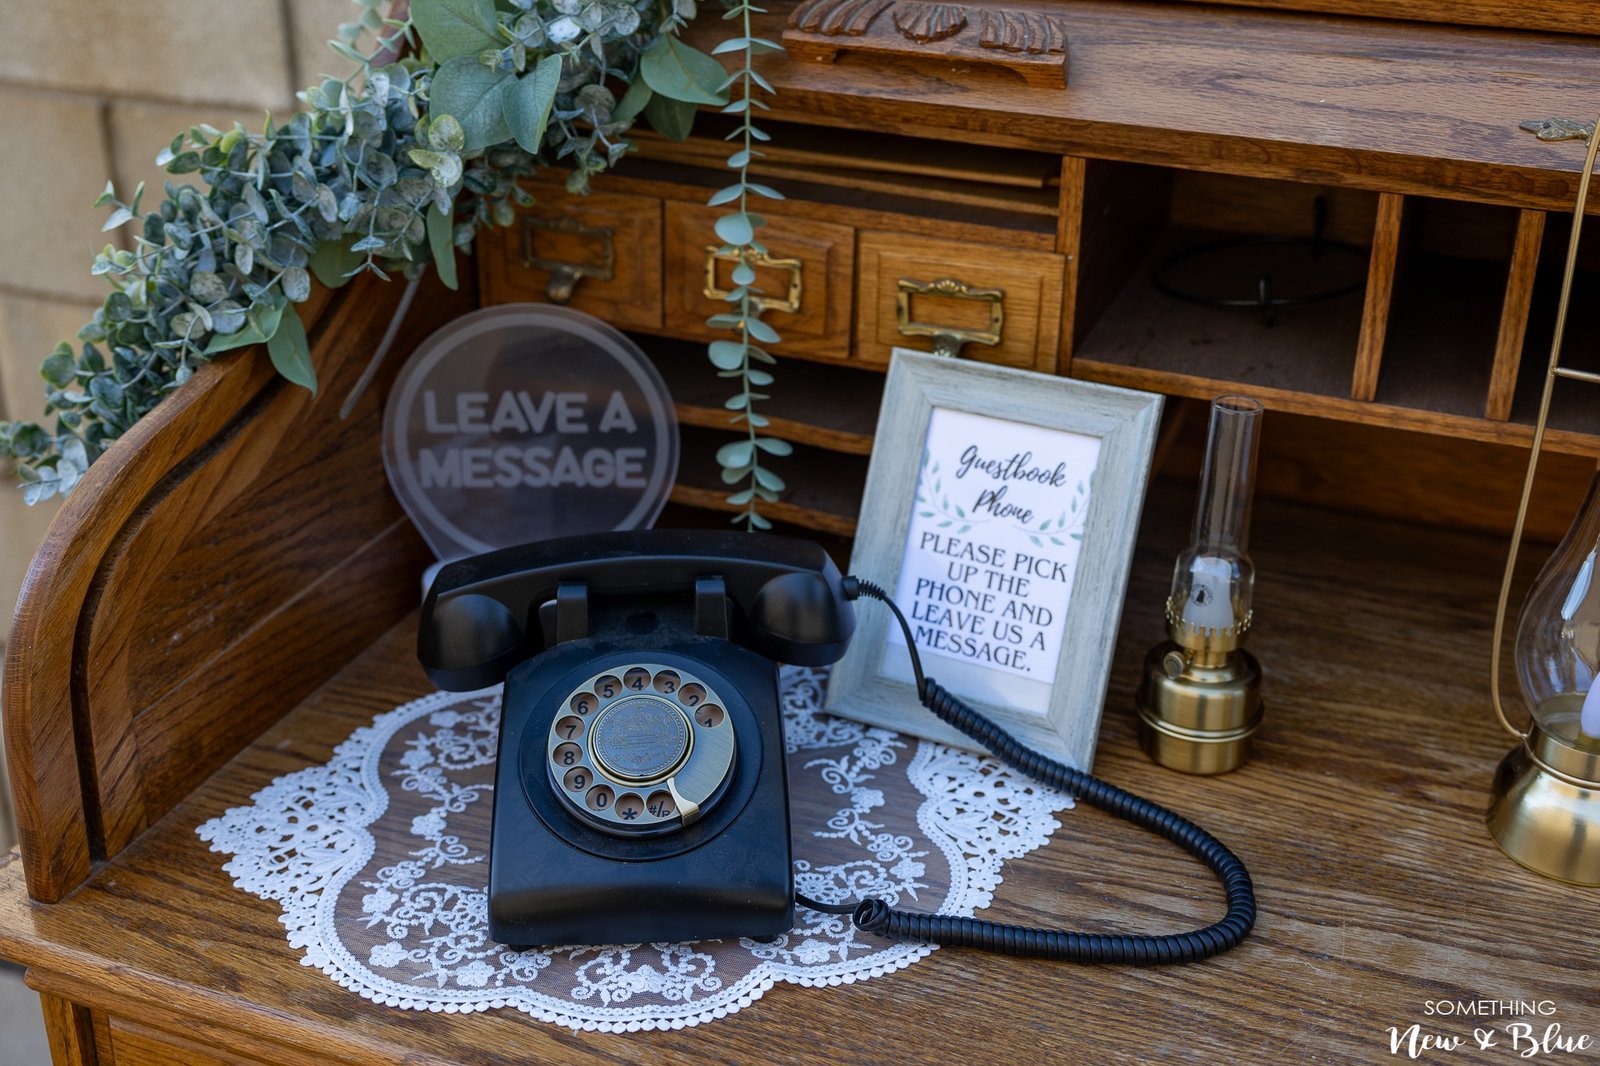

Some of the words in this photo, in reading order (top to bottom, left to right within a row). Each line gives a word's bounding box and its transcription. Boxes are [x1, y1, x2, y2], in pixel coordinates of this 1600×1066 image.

[424, 390, 588, 433] LEAVE
[599, 391, 637, 433] A
[419, 446, 647, 488] MESSAGE
[956, 445, 1066, 487] Guestbook
[972, 486, 1034, 524] Phone
[920, 532, 1006, 568] PLEASE
[1013, 553, 1069, 583] PICK
[947, 562, 978, 584] UP
[985, 570, 1030, 598] THE
[915, 578, 996, 613] PHONE
[1002, 600, 1053, 627] AND
[911, 601, 985, 635] LEAVE
[993, 621, 1023, 645] US
[1030, 632, 1046, 651] A
[915, 626, 1031, 672] MESSAGE.
[603, 684, 614, 698] 5
[632, 678, 643, 691] 4
[664, 681, 676, 694] 3
[577, 701, 589, 715] 6
[689, 695, 700, 707] 2
[565, 725, 577, 740] 7
[563, 751, 575, 766] 8
[574, 775, 586, 790] 9
[596, 793, 608, 807] 0
